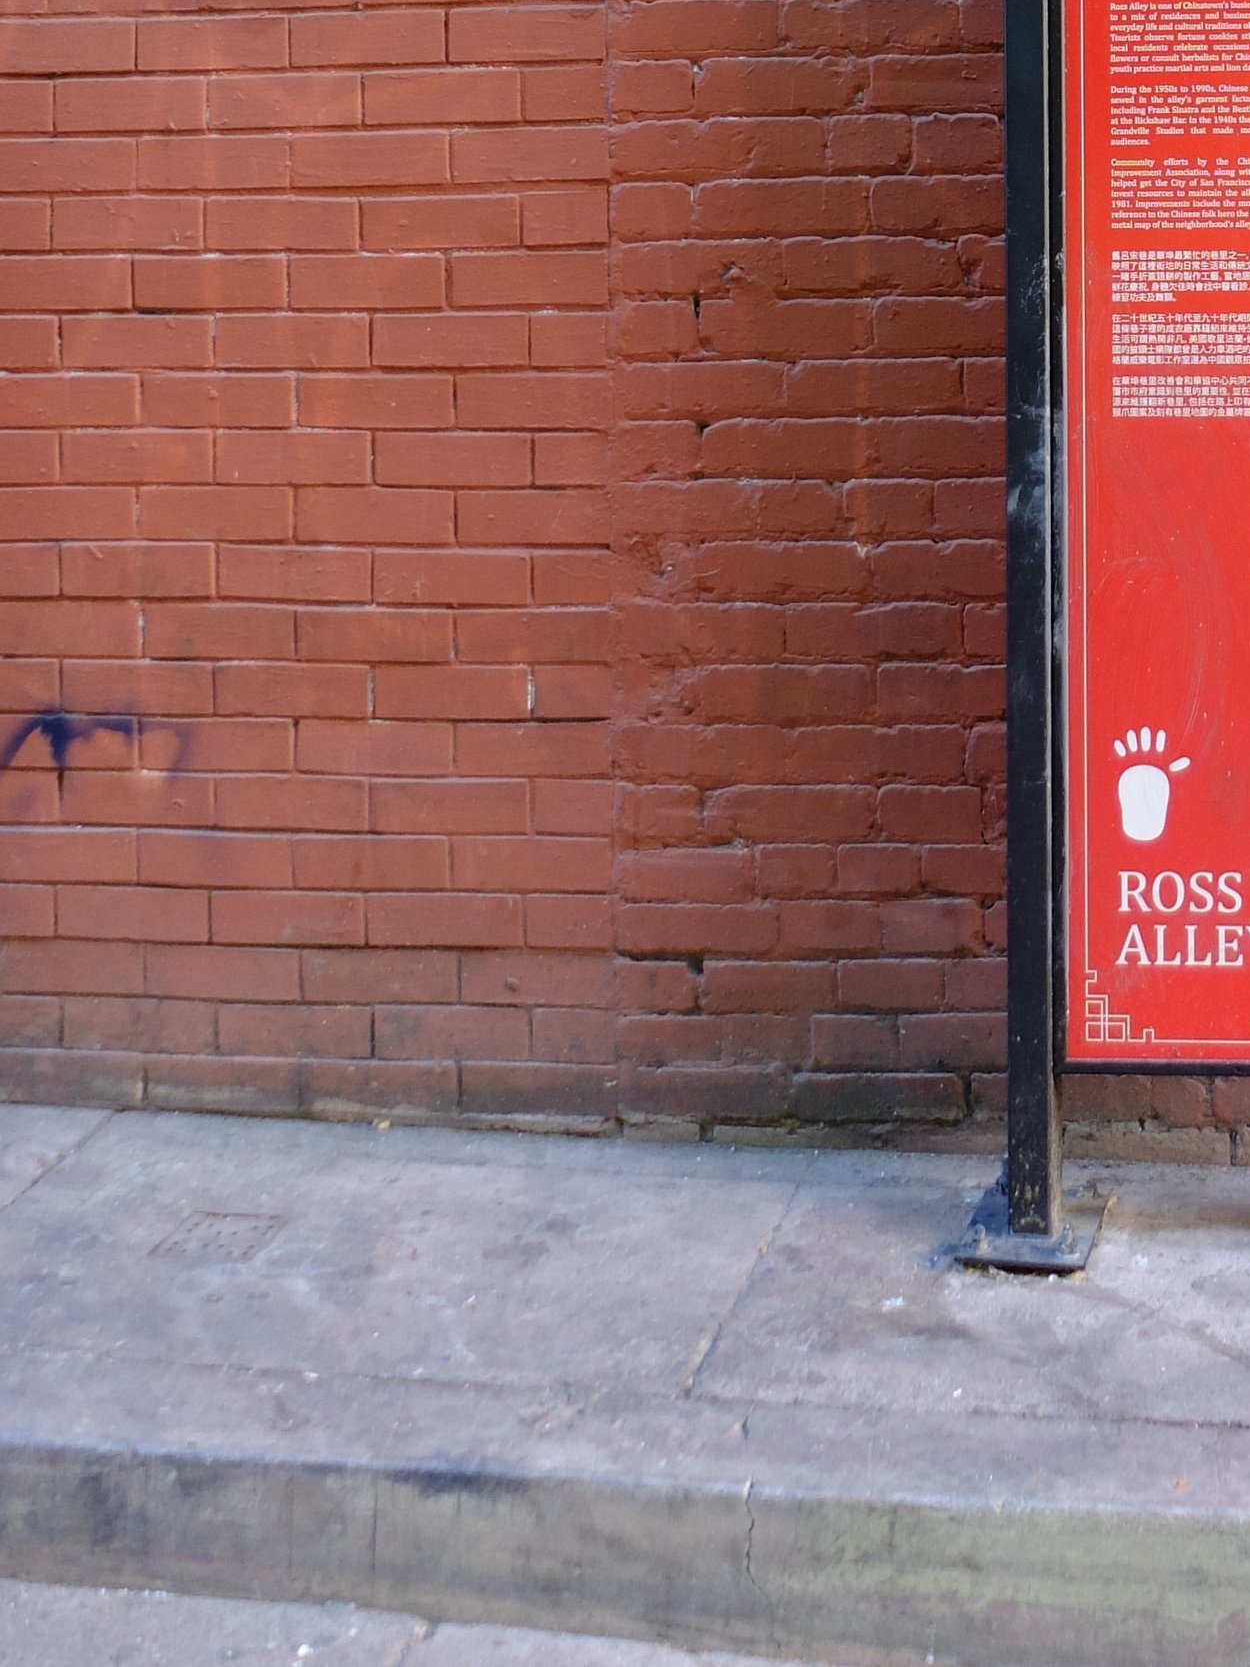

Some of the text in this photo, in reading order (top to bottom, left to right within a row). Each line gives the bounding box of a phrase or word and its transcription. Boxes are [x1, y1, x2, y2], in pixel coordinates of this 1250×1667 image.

[1110, 2, 1128, 11] Ross
[1129, 2, 1148, 12] Alley
[1150, 2, 1156, 11] is
[1158, 3, 1172, 11] one
[1174, 1, 1181, 11] of
[1183, 1, 1229, 10] Chinatown's
[1110, 12, 1118, 21] to
[1131, 12, 1145, 21] mix
[1149, 11, 1157, 21] of
[1161, 11, 1201, 20] residences
[1205, 11, 1219, 20] and
[1110, 22, 1144, 32] everyday
[1145, 22, 1157, 31] life
[1159, 22, 1173, 31] and
[1174, 21, 1203, 31] cultural
[1205, 21, 1242, 30] traditions
[1243, 21, 1250, 30] of
[1110, 32, 1141, 42] Tourists
[1144, 32, 1174, 41] observe
[1177, 32, 1206, 41] fortune
[1209, 32, 1238, 41] cookies
[1110, 43, 1128, 52] local
[1133, 43, 1168, 52] residents
[1173, 43, 1208, 52] celebrate
[1213, 42, 1250, 51] occasions
[1110, 53, 1138, 62] flowers
[1152, 53, 1179, 62] consult
[1182, 53, 1219, 62] herbalists
[1222, 53, 1232, 62] for
[1111, 64, 1132, 74] youth
[1134, 64, 1164, 74] practice
[1165, 64, 1192, 73] martial
[1194, 64, 1209, 73] arts
[1210, 63, 1225, 73] and
[1226, 63, 1241, 73] lion
[1110, 84, 1137, 95] During
[1139, 84, 1152, 94] the
[1155, 84, 1178, 93] 1950s
[1180, 84, 1188, 93] to
[1218, 84, 1248, 93] Chinese
[1111, 95, 1134, 104] sewed
[1139, 95, 1146, 104] in
[1151, 95, 1163, 104] the
[1168, 95, 1191, 105] alley's
[1196, 94, 1227, 105] garment
[1111, 105, 1146, 115] including
[1148, 105, 1170, 114] Frank
[1172, 105, 1199, 114] Sinatra
[1201, 105, 1215, 114] and
[1217, 105, 1230, 114] the
[1111, 126, 1149, 135] Grandville
[1156, 126, 1184, 135] Studios
[1191, 126, 1206, 135] that
[1213, 126, 1234, 135] made
[1111, 157, 1154, 168] Community
[1164, 157, 1188, 166] efforts
[1198, 157, 1207, 168] by
[1216, 157, 1228, 166] the
[1111, 168, 1162, 178] Improvement
[1214, 167, 1235, 178] along
[1111, 178, 1137, 189] helped
[1140, 178, 1152, 189] get
[1155, 178, 1168, 187] the
[1171, 178, 1186, 189] City
[1189, 178, 1197, 187] of
[1200, 178, 1214, 187] San
[1111, 189, 1134, 198] invest
[1137, 190, 1174, 198] resources
[1177, 188, 1185, 198] to
[1188, 188, 1222, 198] maintain
[1225, 188, 1238, 198] the
[1135, 199, 1190, 210] Improvements
[1193, 199, 1220, 208] include
[1223, 199, 1236, 208] the
[1112, 209, 1147, 219] reference
[1148, 209, 1156, 219] to
[1157, 209, 1169, 219] the
[1171, 209, 1200, 219] Chinese
[1202, 209, 1216, 218] folk
[1217, 209, 1235, 218] hero
[1236, 209, 1249, 218] the
[1112, 220, 1133, 229] metal
[1134, 222, 1151, 230] map
[1152, 220, 1160, 229] of
[1161, 220, 1174, 229] the
[1176, 220, 1234, 230] neighborhood's
[1118, 871, 1243, 913] ROSS
